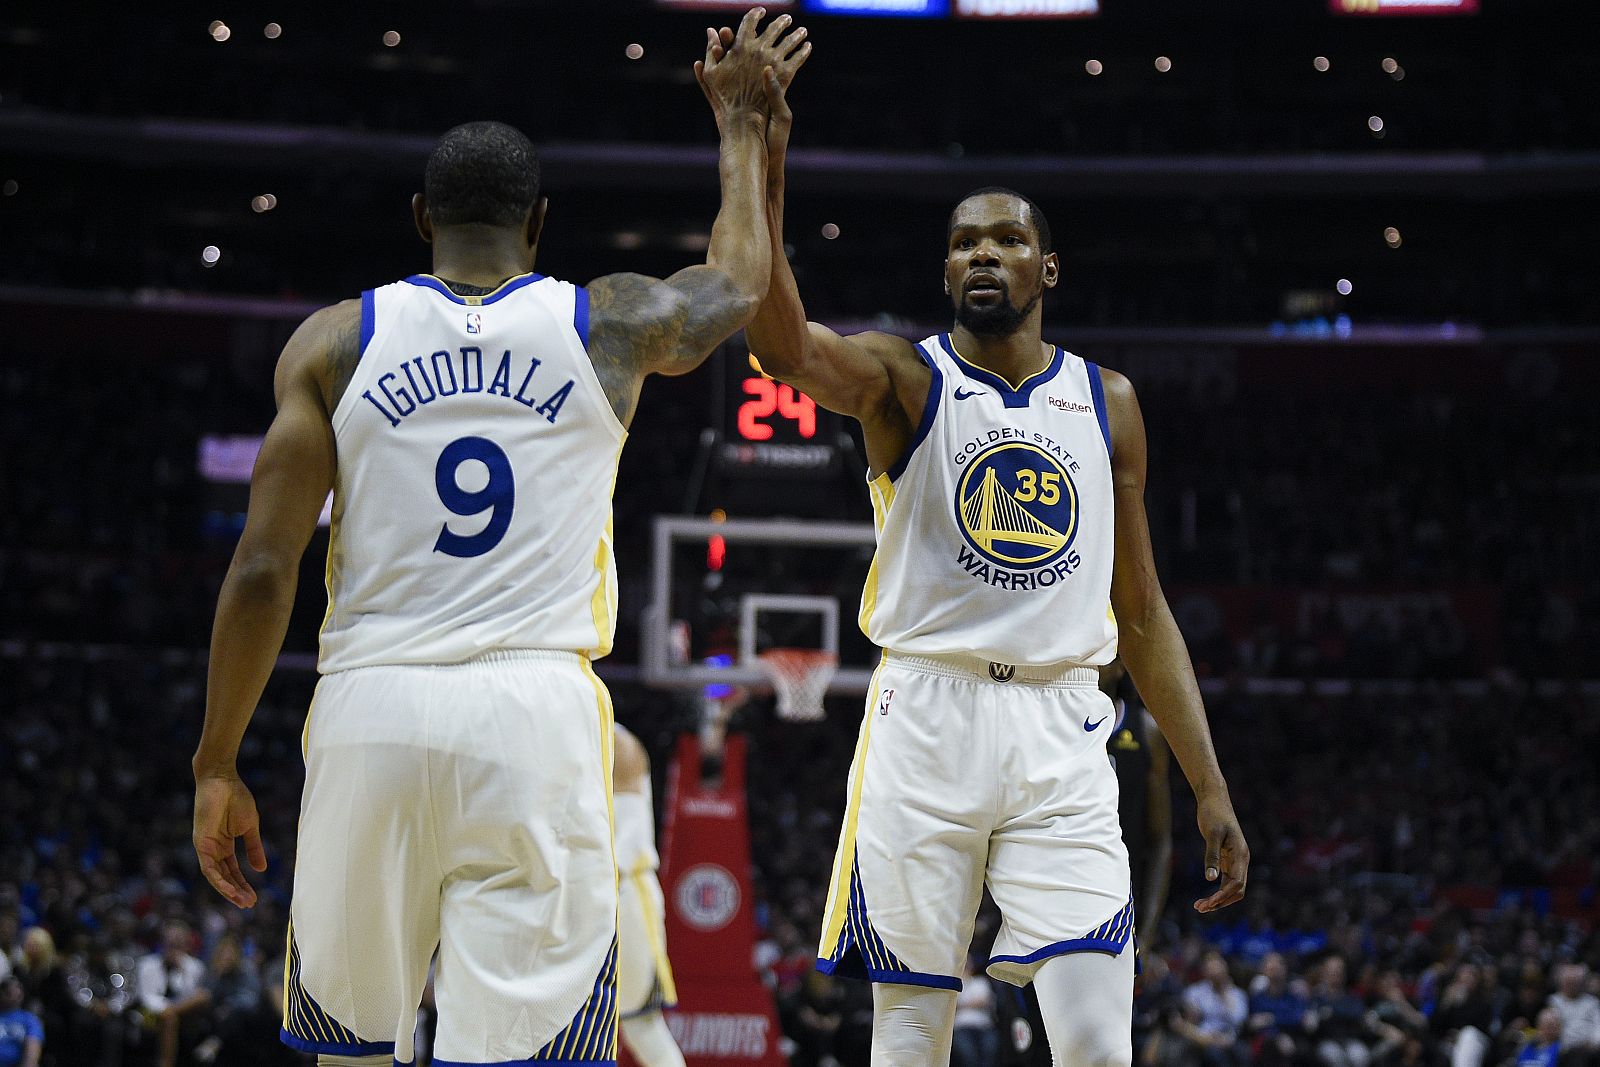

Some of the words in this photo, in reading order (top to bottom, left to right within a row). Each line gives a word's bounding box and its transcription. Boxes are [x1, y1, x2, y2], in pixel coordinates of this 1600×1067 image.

[362, 346, 575, 427] IGUODALA
[737, 376, 817, 441] 24
[1048, 396, 1092, 413] Rakuten
[954, 427, 1025, 466] GOLDEN
[1033, 432, 1081, 474] STATE
[433, 436, 515, 558] 9
[1013, 468, 1061, 506] 35
[956, 544, 1081, 591] WARRIORS
